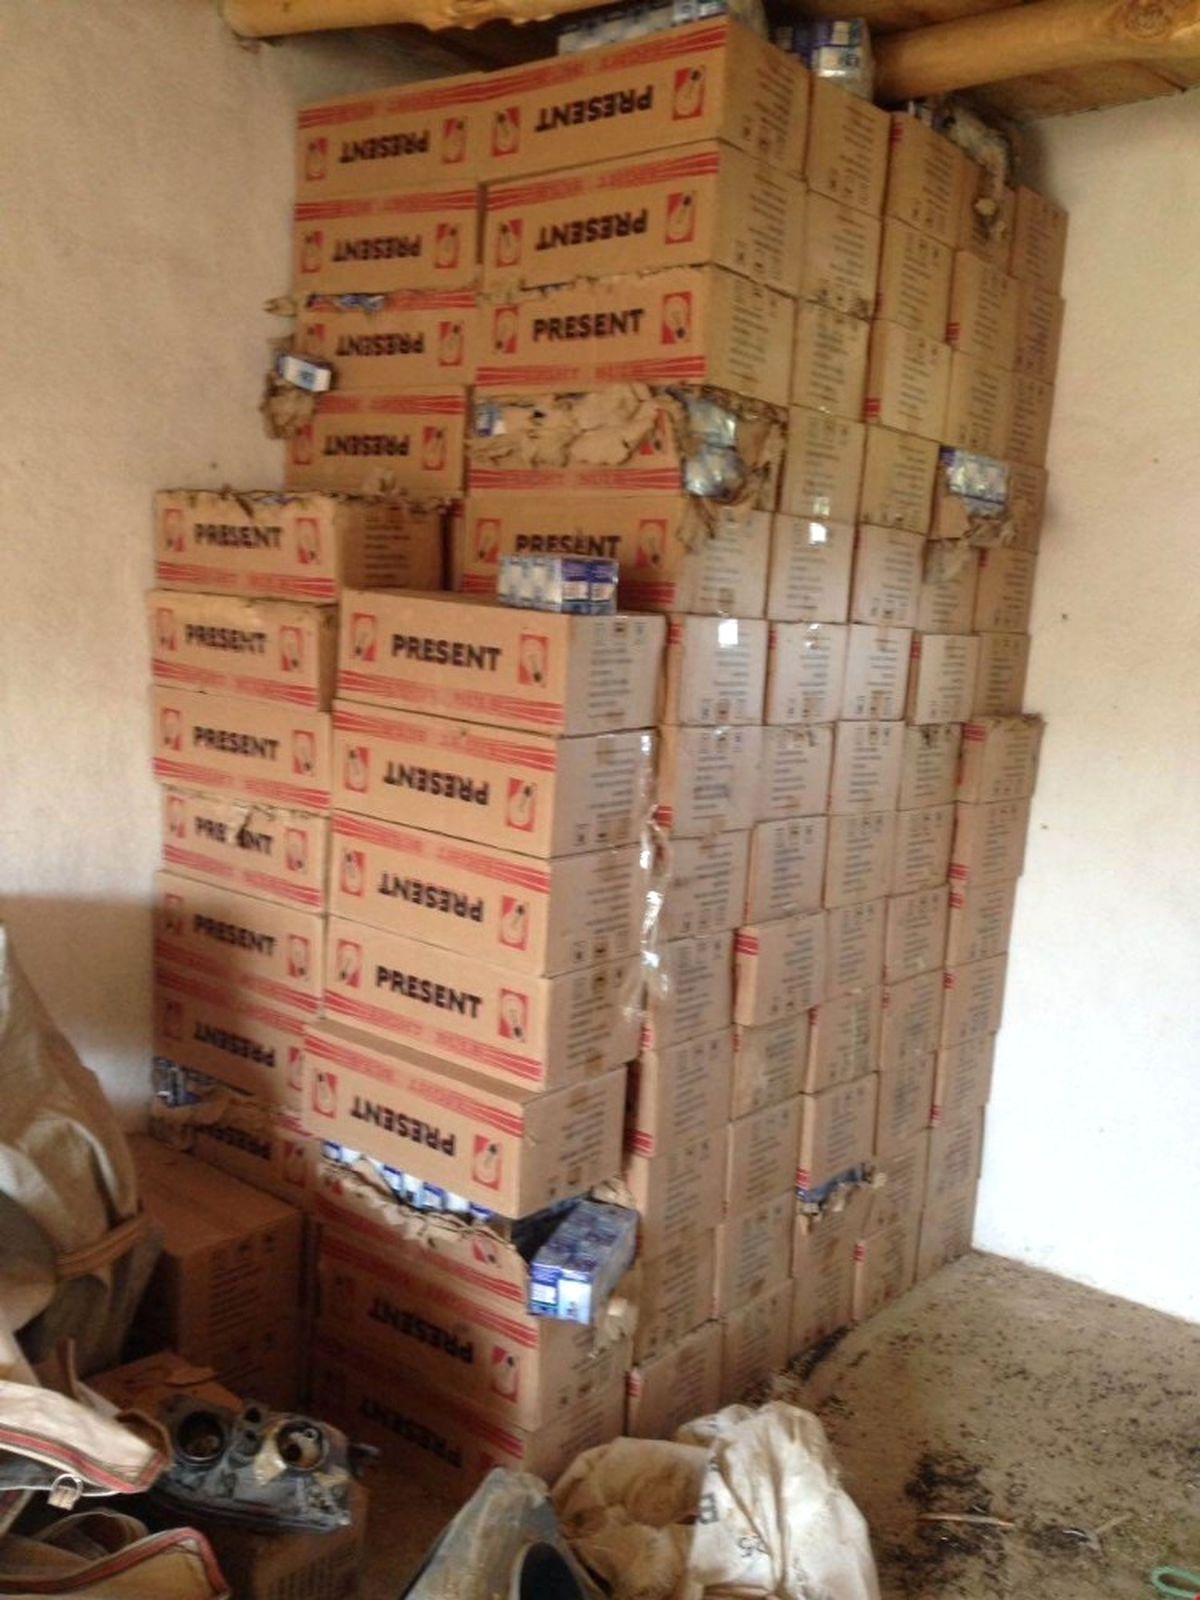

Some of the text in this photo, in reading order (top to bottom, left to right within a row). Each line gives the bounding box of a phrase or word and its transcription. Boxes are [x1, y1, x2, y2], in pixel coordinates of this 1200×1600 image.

[534, 85, 654, 132] PRESENT
[338, 131, 430, 163] PRESENT
[332, 236, 421, 262] PRESENT
[534, 209, 648, 251] PRESENT
[532, 308, 645, 342] PRESENT
[336, 333, 425, 357] PRESENT
[323, 434, 410, 457] PRESENT
[195, 523, 283, 549] PRESENT
[185, 624, 267, 654] PRESENT
[392, 633, 502, 671] PRESENT
[193, 726, 279, 760] PRESENT
[384, 762, 489, 805] PRESENT
[378, 872, 484, 922] PRESENT
[193, 915, 276, 955] PRESENT
[376, 966, 483, 1018] PRESENT
[194, 1026, 276, 1068] PRESENT
[350, 1096, 455, 1156] PRESENT
[368, 1299, 474, 1365] PRESENT
